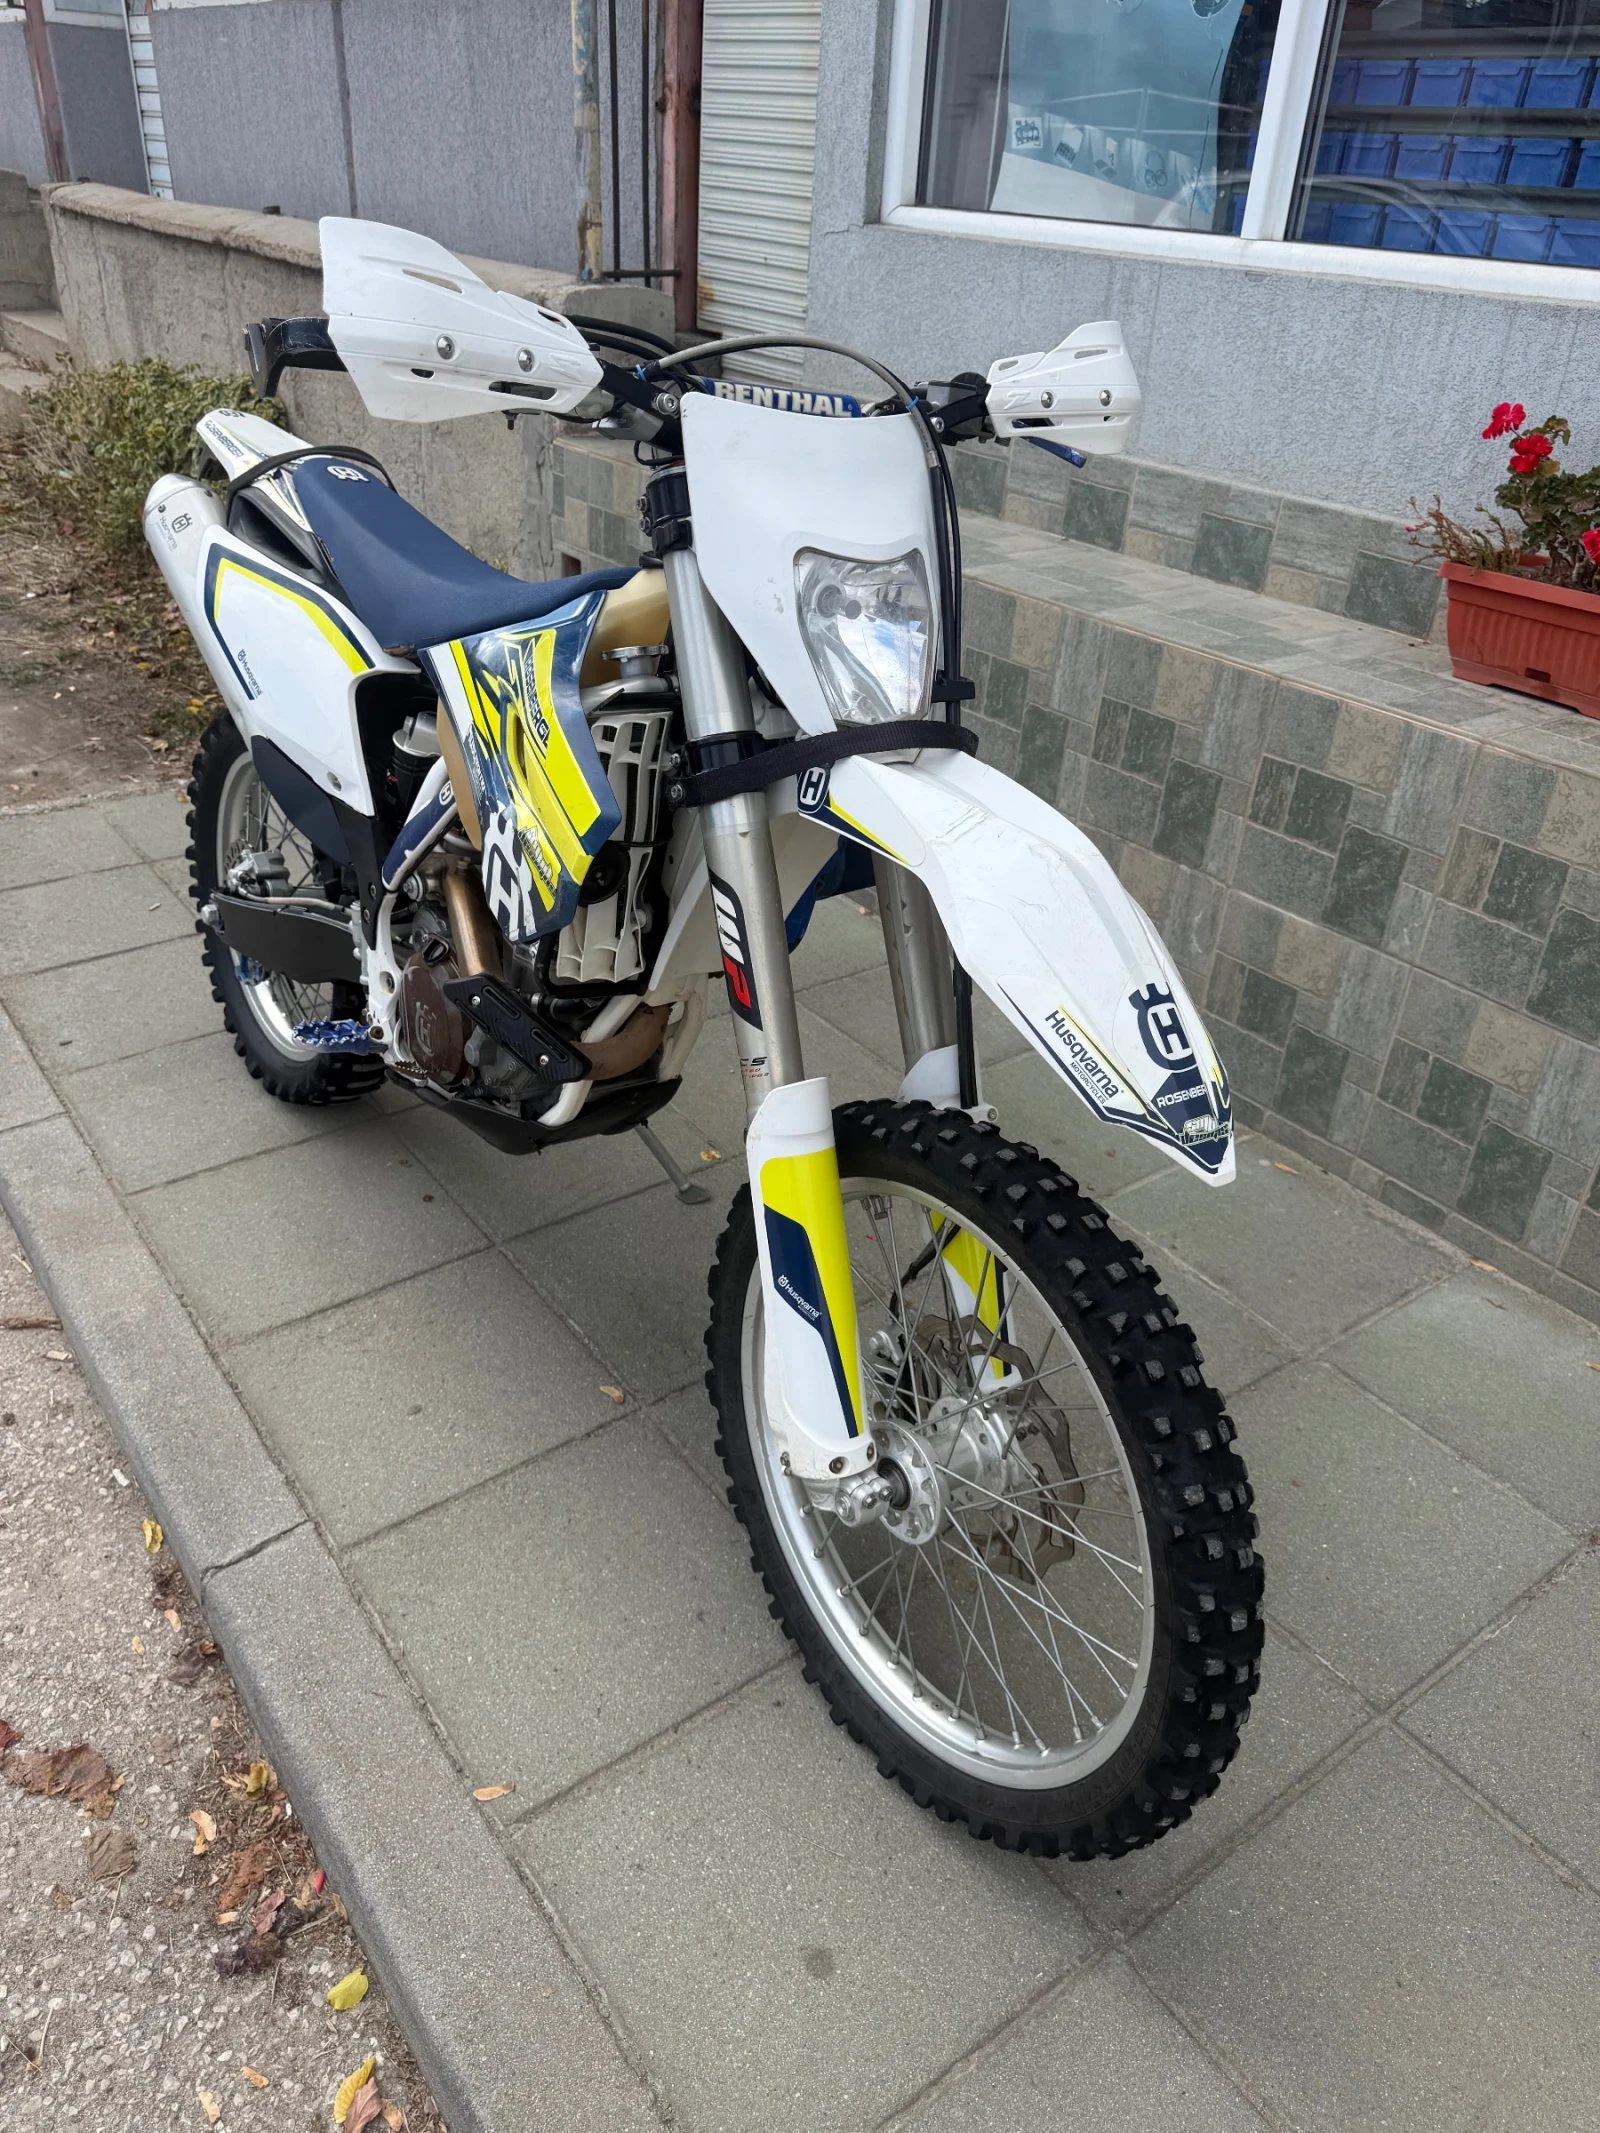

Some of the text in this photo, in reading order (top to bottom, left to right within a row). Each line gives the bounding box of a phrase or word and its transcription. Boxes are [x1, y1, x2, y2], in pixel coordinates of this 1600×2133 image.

[715, 381, 851, 417] RENTHAL
[1045, 1010, 1119, 1099] Husqvarna
[1069, 1061, 1106, 1105] MOTORCYCLES
[785, 1284, 820, 1317] Husqvarna
